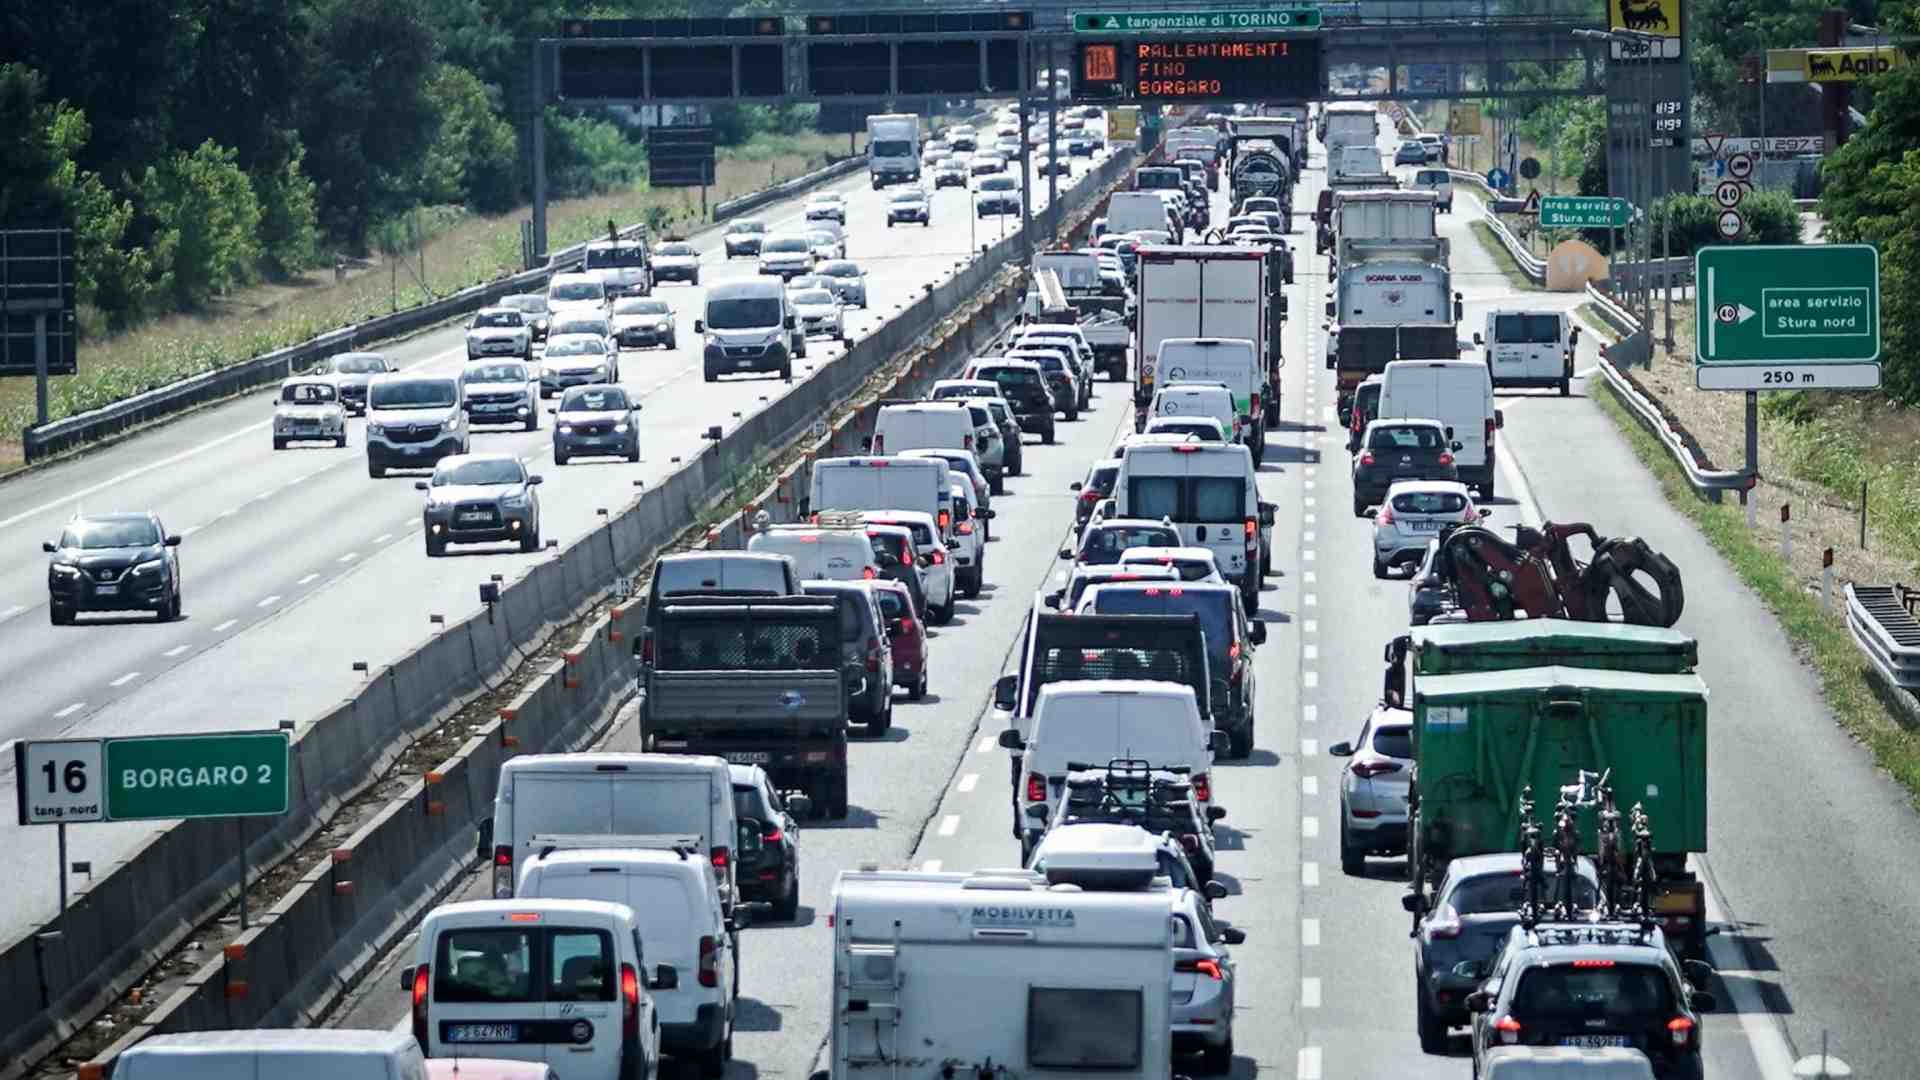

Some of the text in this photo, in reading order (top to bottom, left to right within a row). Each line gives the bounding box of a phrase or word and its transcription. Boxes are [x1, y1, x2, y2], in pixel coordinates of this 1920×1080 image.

[1127, 13, 1290, 28] tangenziale di TORINO
[1138, 43, 1289, 58] RALLENTAMENTI
[1139, 63, 1185, 76] FINO
[1839, 53, 1889, 77] Agip
[1139, 80, 1221, 95] BORGARO
[1721, 188, 1737, 200] 40
[1544, 201, 1621, 210] area servizo
[1552, 213, 1583, 223] Stura
[1769, 295, 1862, 308] area servizio
[1721, 309, 1734, 318] 40
[1777, 316, 1855, 329] Stura nord
[1763, 371, 1815, 383] 250 m
[41, 760, 87, 793] 16
[122, 765, 272, 788] BORGARO 2
[34, 804, 97, 817] tang. nord
[972, 907, 1075, 919] MOBILVETTA
